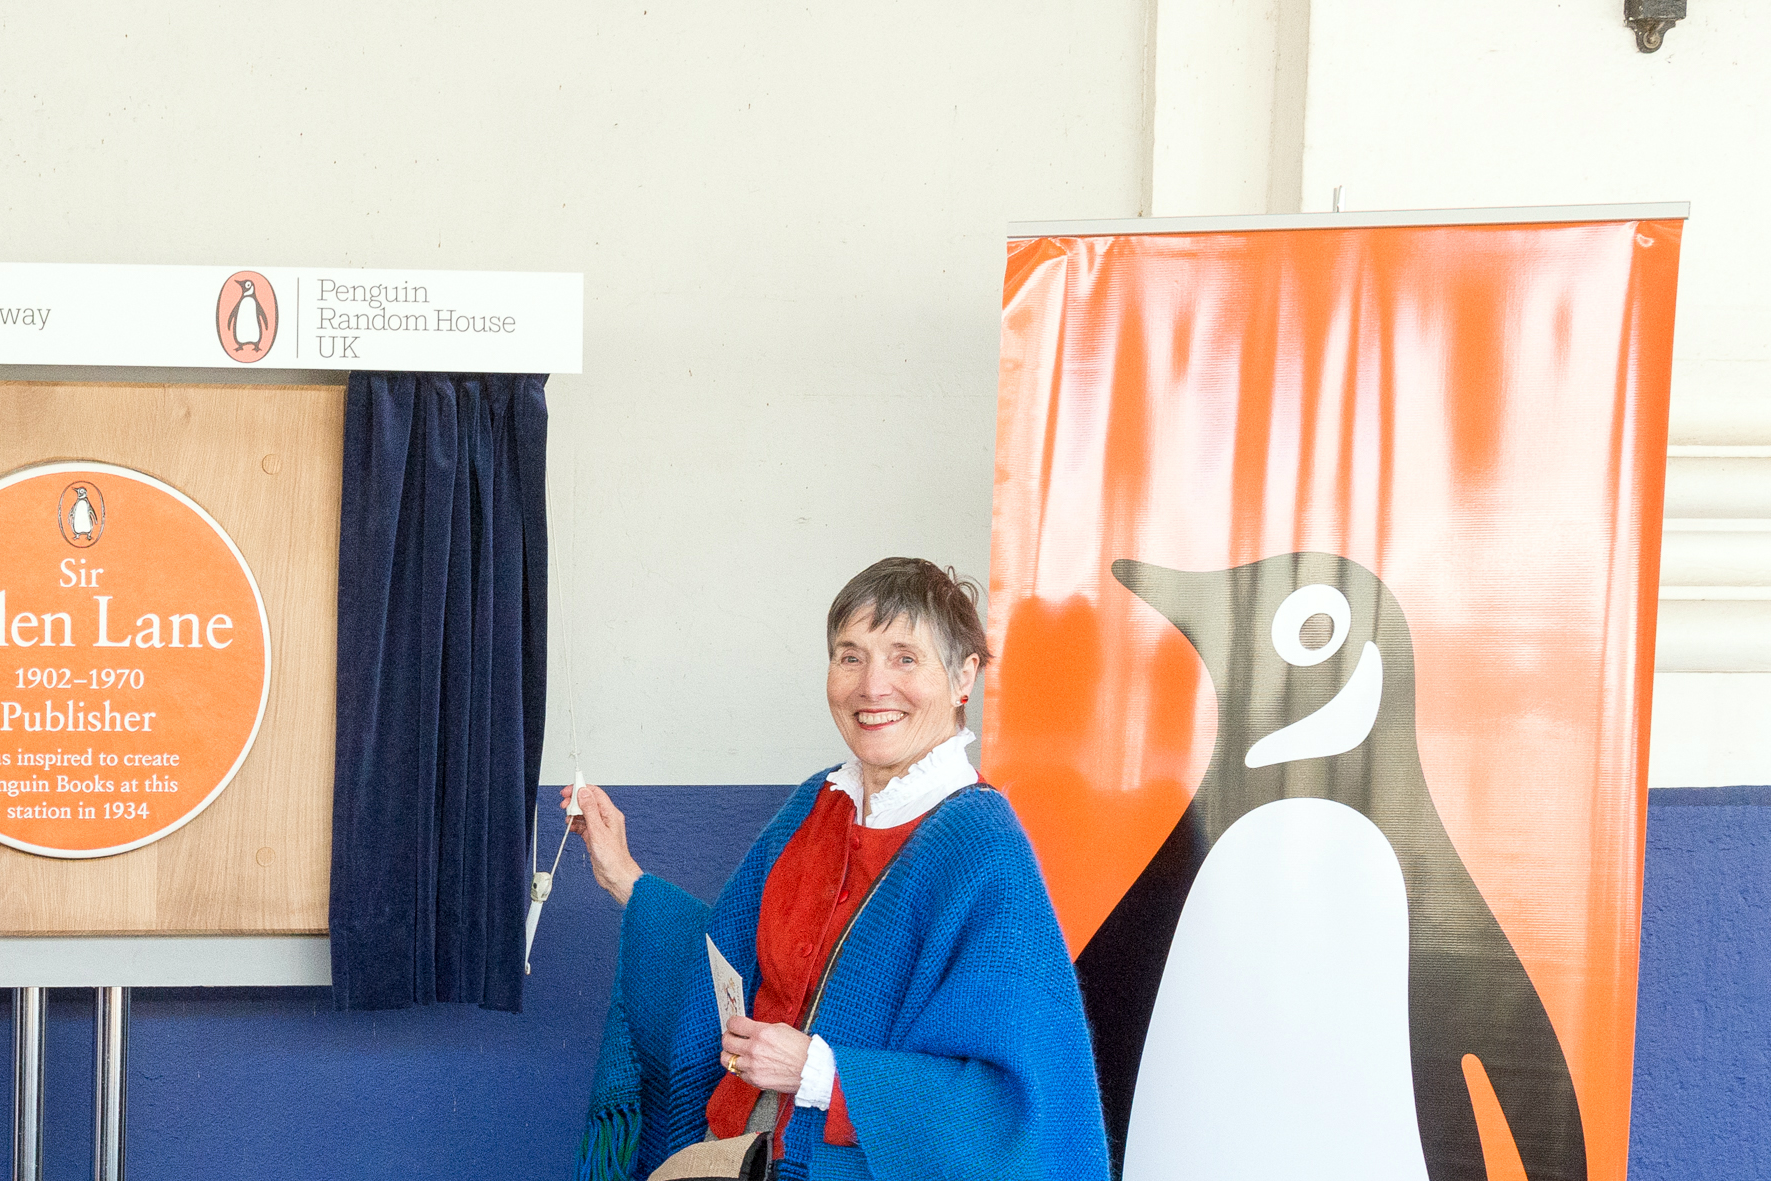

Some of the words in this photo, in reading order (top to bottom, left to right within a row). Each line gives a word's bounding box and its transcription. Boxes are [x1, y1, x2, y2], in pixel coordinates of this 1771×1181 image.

[316, 278, 430, 309] Penguin
[316, 307, 430, 332] Random
[432, 309, 517, 334] House
[315, 335, 361, 359] UK
[58, 557, 105, 588] Sir
[92, 595, 234, 650] Lane
[0, 700, 157, 732] Publisher
[17, 748, 93, 771] inspired
[98, 751, 118, 767] to
[123, 751, 180, 767] create
[56, 775, 115, 793] Books
[120, 778, 140, 793] at
[144, 775, 179, 793] this
[6, 801, 72, 820] station
[77, 801, 96, 820] in
[102, 801, 150, 820] 1934
